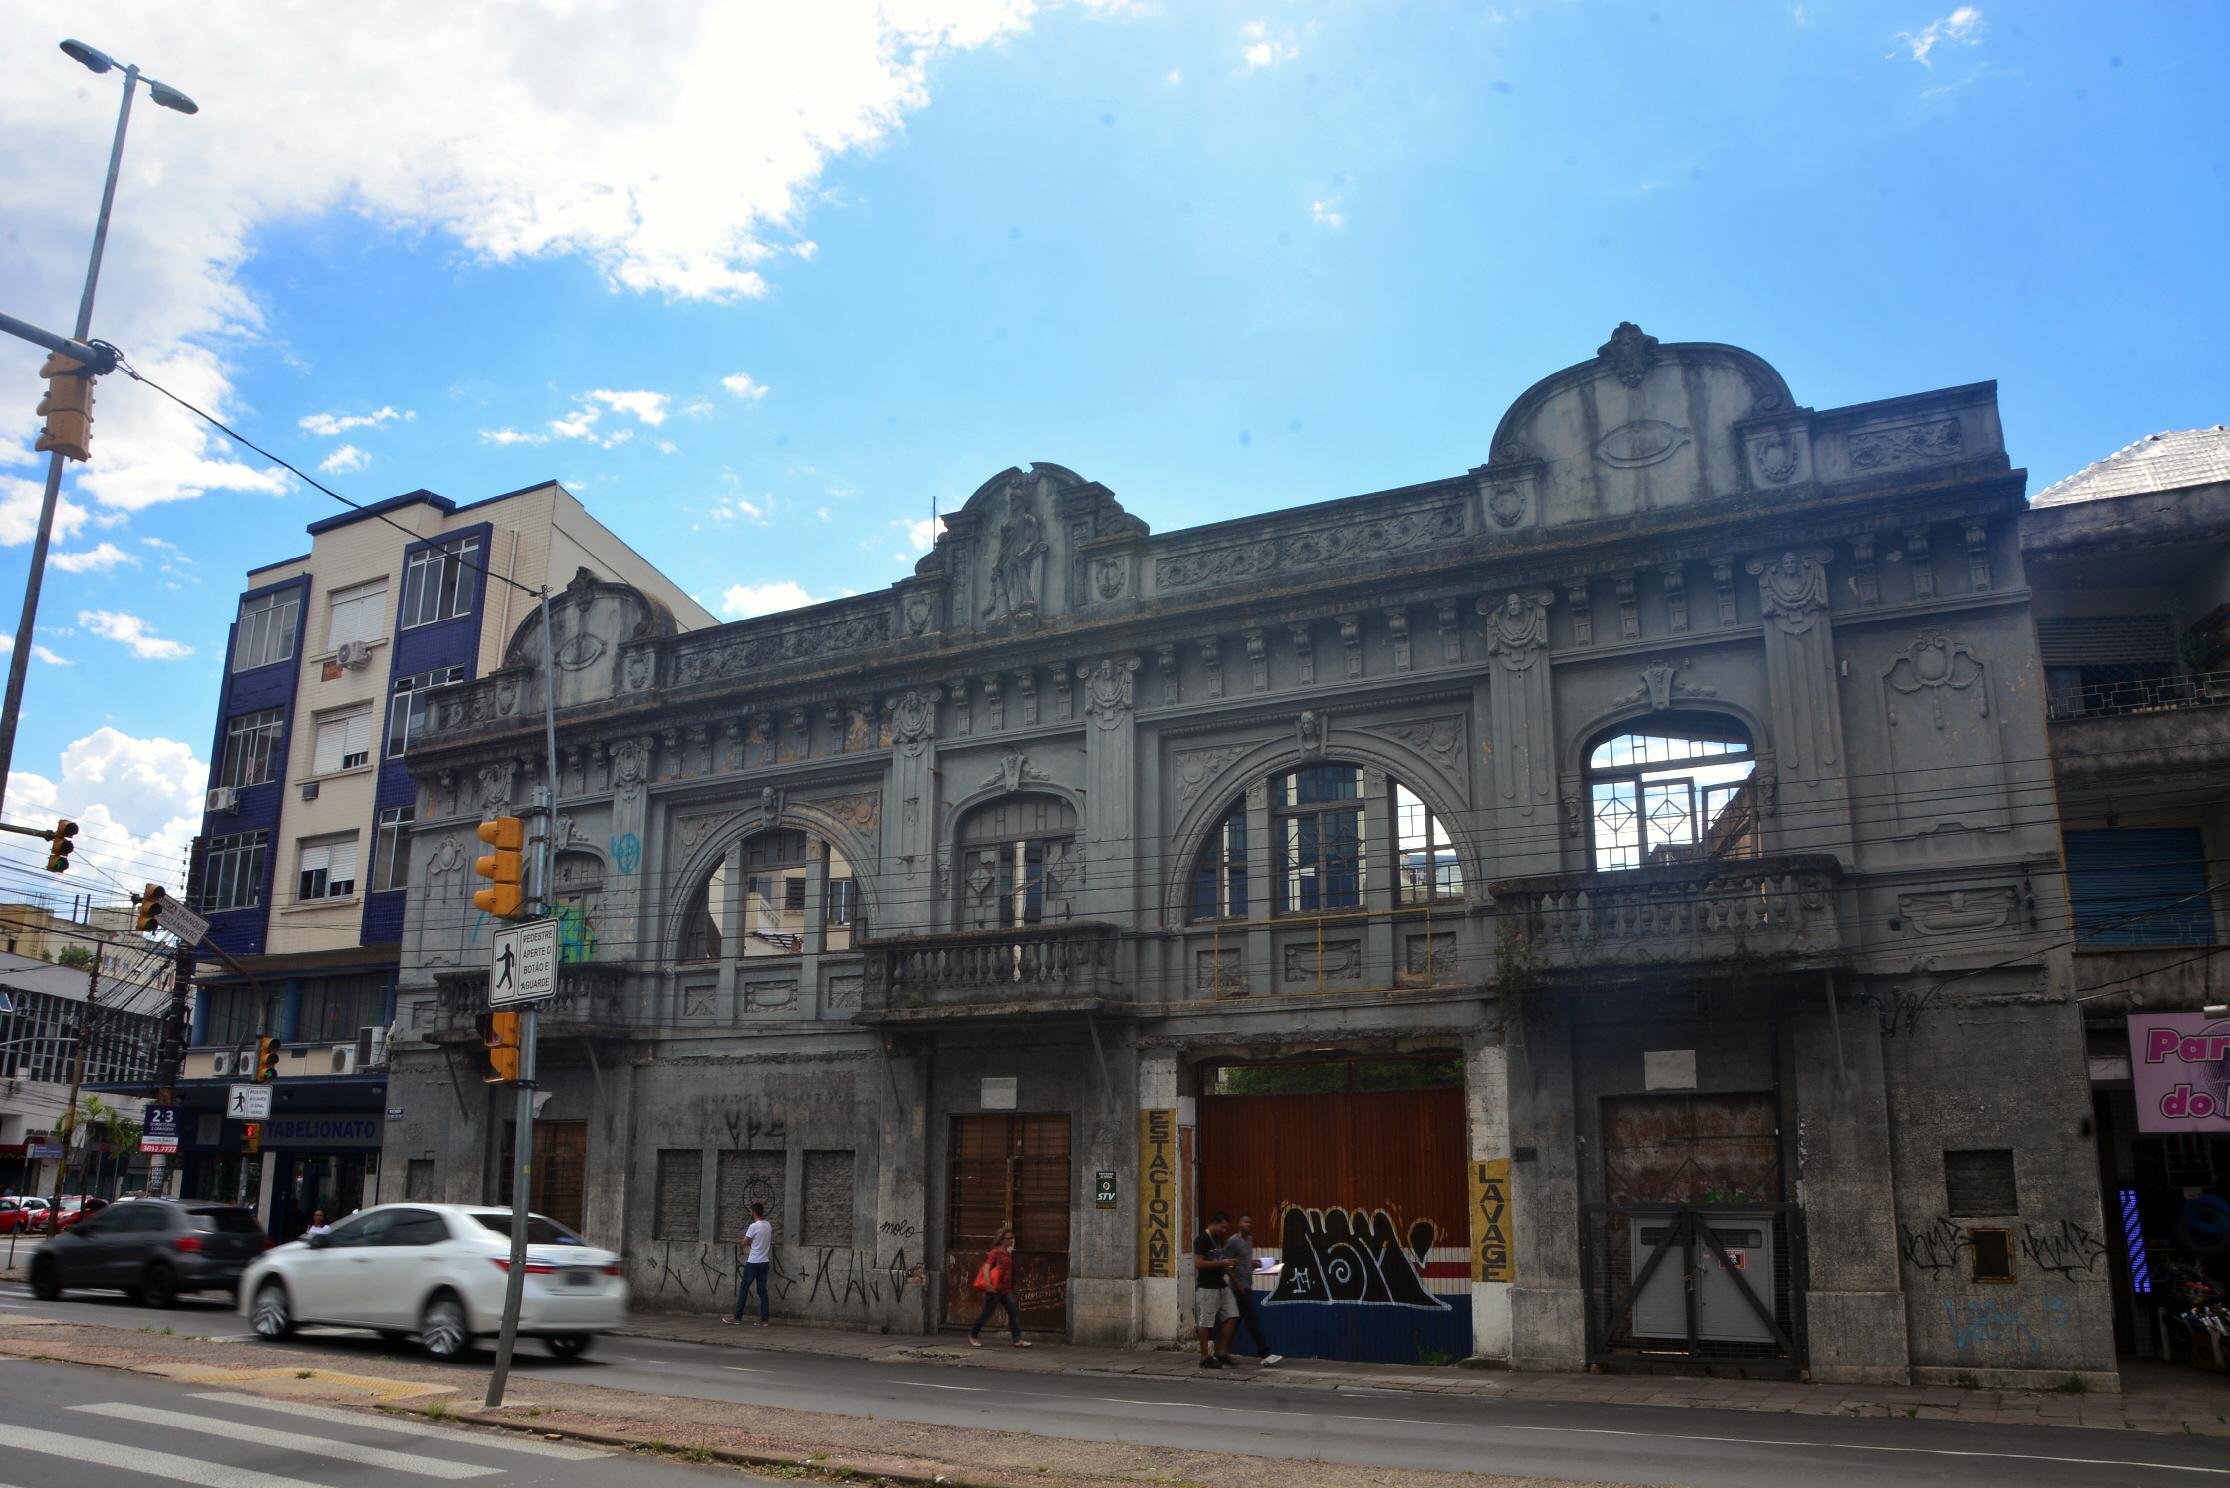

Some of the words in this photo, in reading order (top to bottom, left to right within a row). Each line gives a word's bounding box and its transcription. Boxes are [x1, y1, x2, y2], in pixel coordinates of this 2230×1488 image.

[523, 930, 552, 944] PEDESTRE
[523, 947, 545, 959] APERTE
[547, 946, 551, 954] O
[524, 962, 543, 974] BOTÃO
[545, 962, 549, 970] E
[521, 978, 550, 990] AGUARDE
[2159, 1083, 2216, 1119] do
[267, 1120, 376, 1138] TABELIONATO
[1096, 1192, 1116, 1201] STV
[1148, 1110, 1170, 1278] ESTACIONAME
